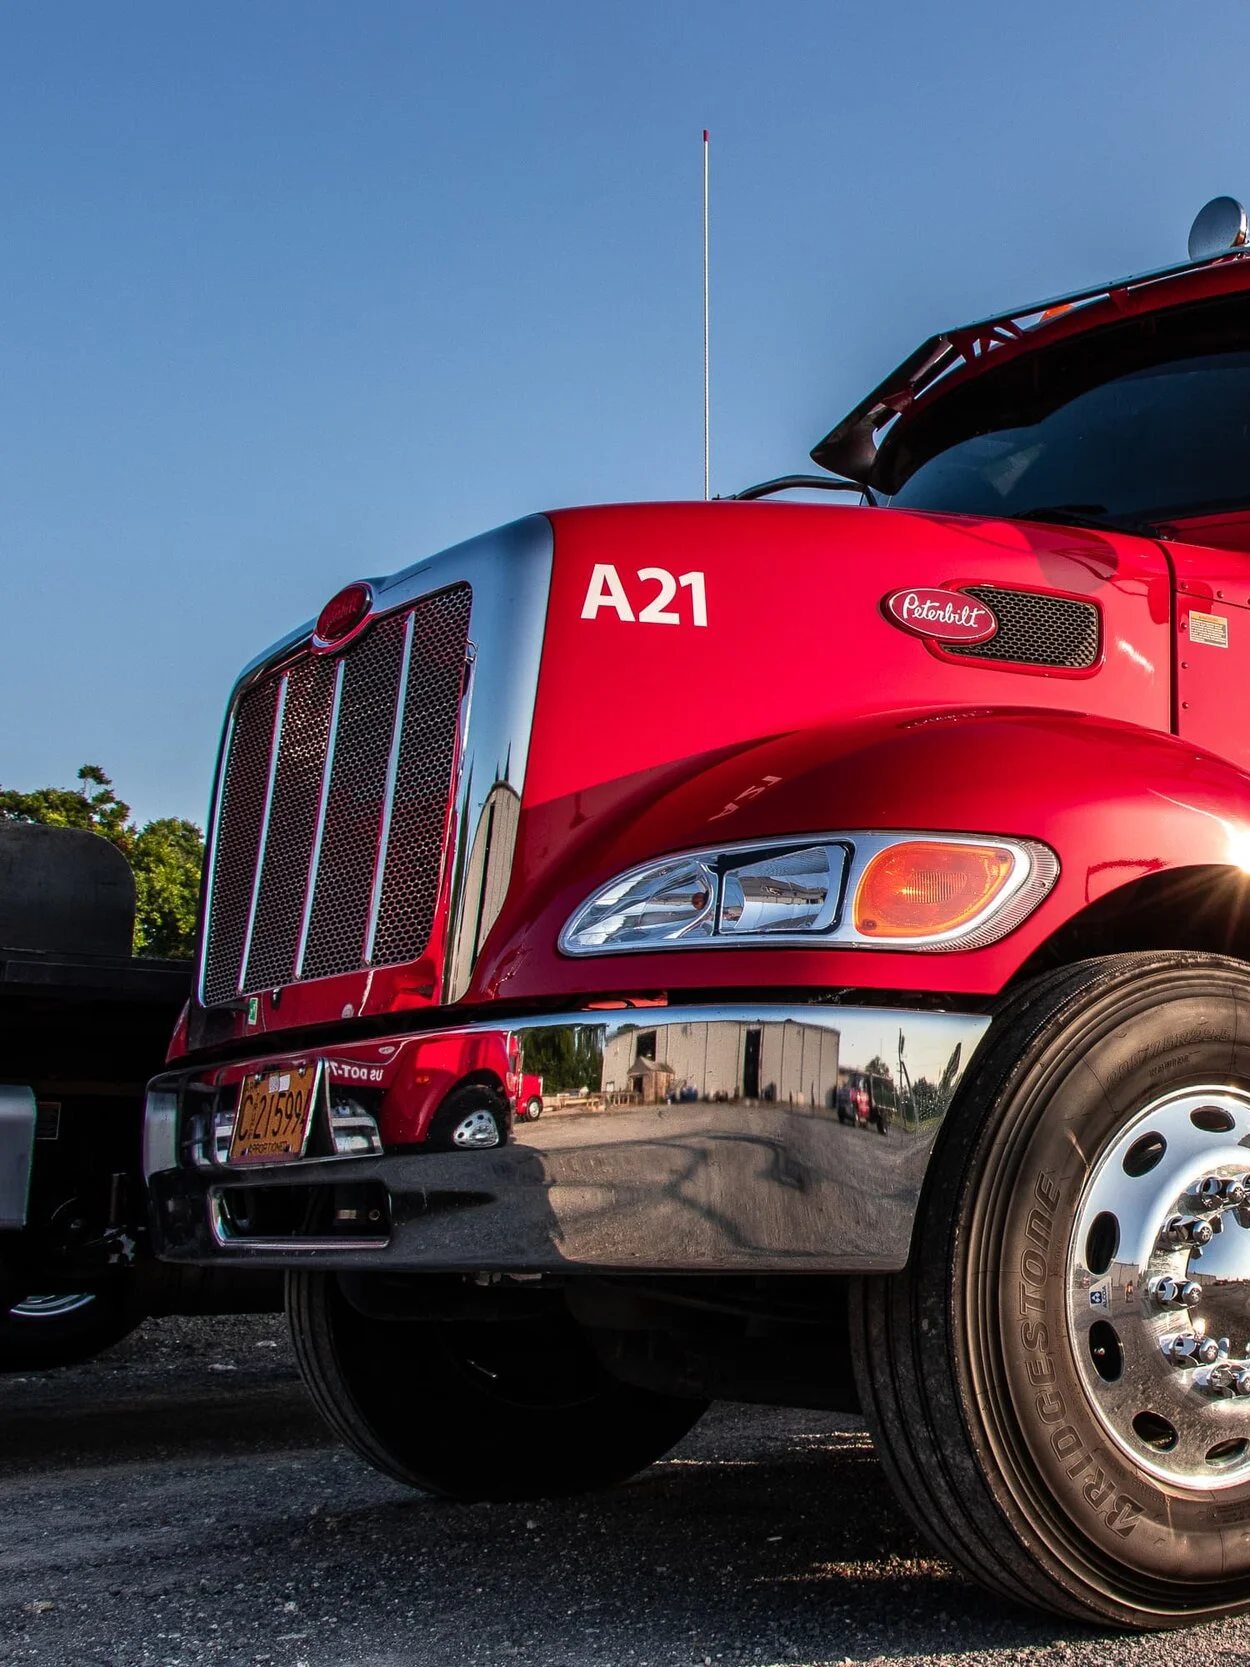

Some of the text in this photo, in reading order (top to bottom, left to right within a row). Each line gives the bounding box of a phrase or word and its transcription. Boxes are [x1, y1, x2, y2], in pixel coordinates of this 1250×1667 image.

[581, 563, 708, 627] A21
[903, 593, 985, 628] Peterbilt
[1020, 1170, 1146, 1540] BRIDGESTONE
